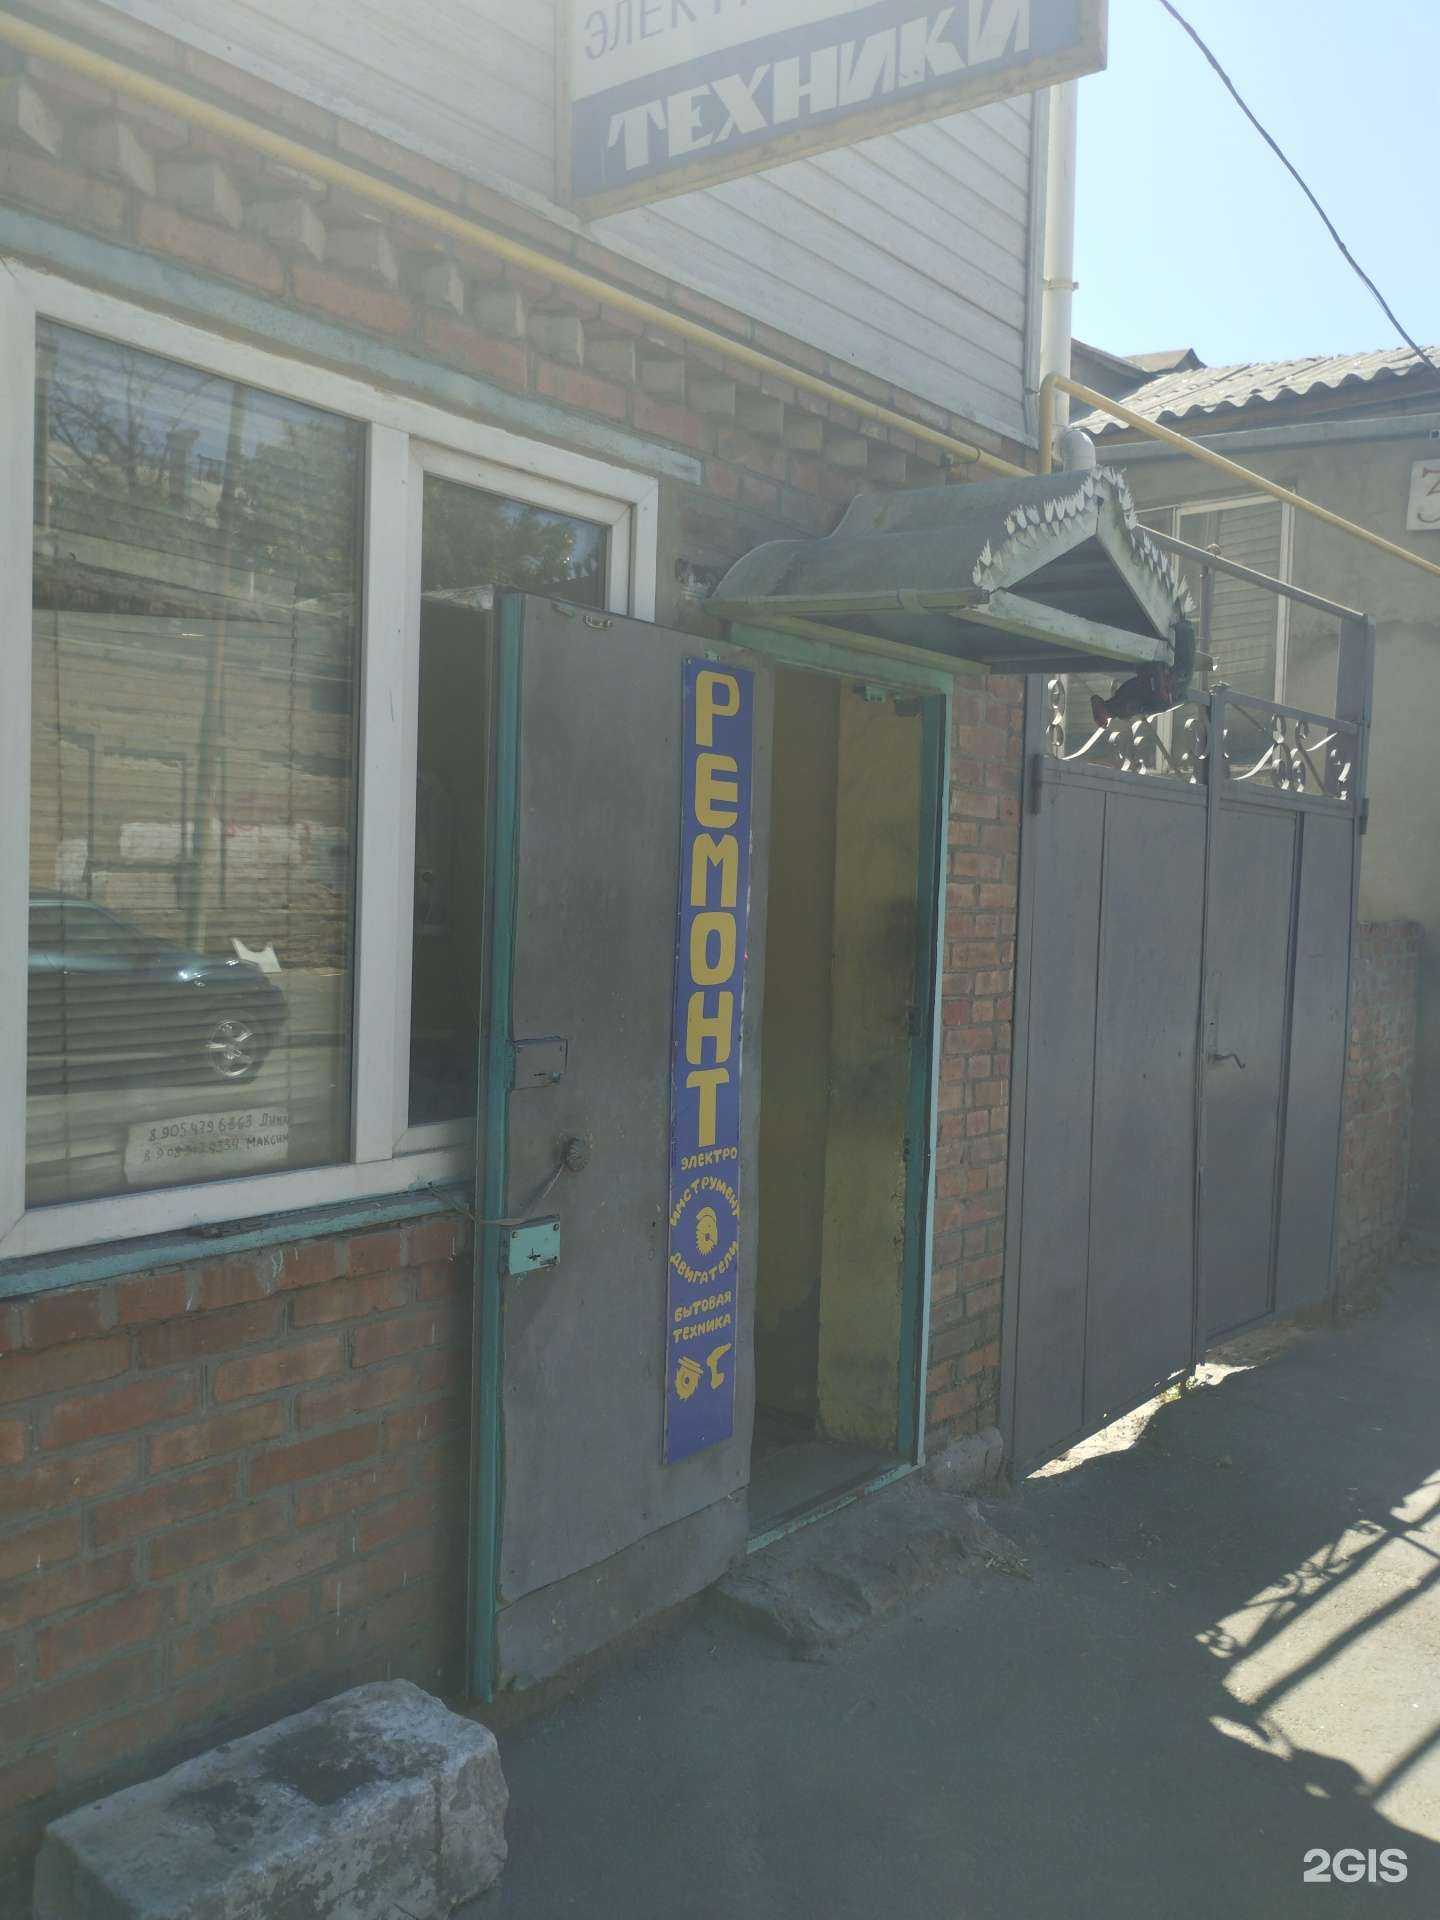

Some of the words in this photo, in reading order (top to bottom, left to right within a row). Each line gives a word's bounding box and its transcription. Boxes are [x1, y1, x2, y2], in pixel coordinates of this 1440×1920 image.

[608, 0, 1031, 172] ТЕХНИКИ
[685, 669, 741, 1148] РЕМОНТ
[681, 1147, 738, 1170] ЭЛЕКТРО
[672, 1314, 732, 1343] ТЕХНИКА
